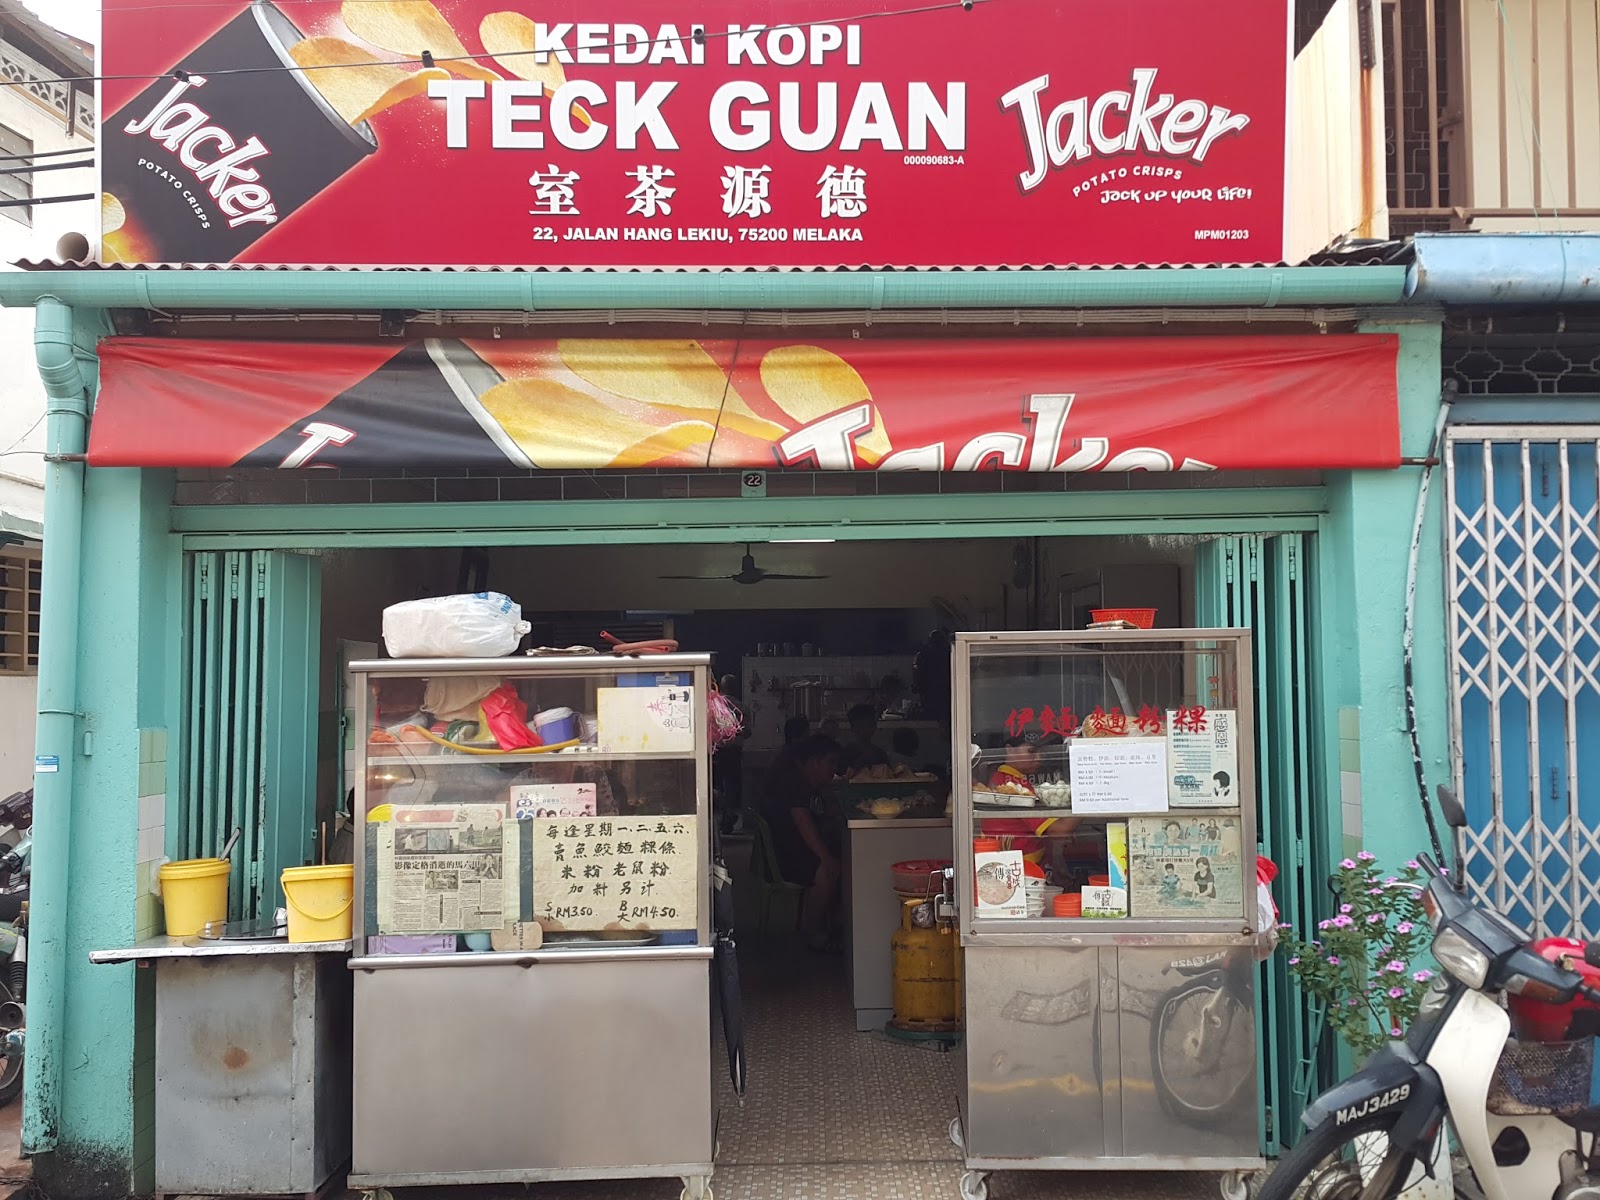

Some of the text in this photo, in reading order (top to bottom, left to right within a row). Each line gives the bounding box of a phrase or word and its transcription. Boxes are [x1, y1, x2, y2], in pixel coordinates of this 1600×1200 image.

[534, 23, 861, 66] KEDAI KOPI
[427, 80, 967, 152] TECK GUAN
[1000, 68, 1250, 191] Jacker
[123, 71, 278, 228] Jacker
[903, 155, 965, 165] 000090683-A
[137, 158, 211, 229] POTATO CRISPS
[1072, 165, 1183, 197] POTATO CRISPS
[532, 226, 863, 243] 22, JALAN HANG LEKIU, 75200 MELAKA
[1194, 229, 1250, 240] MPM01203
[747, 474, 761, 486] 22
[619, 901, 628, 911] B
[1336, 1084, 1410, 1126] MAJ3429
